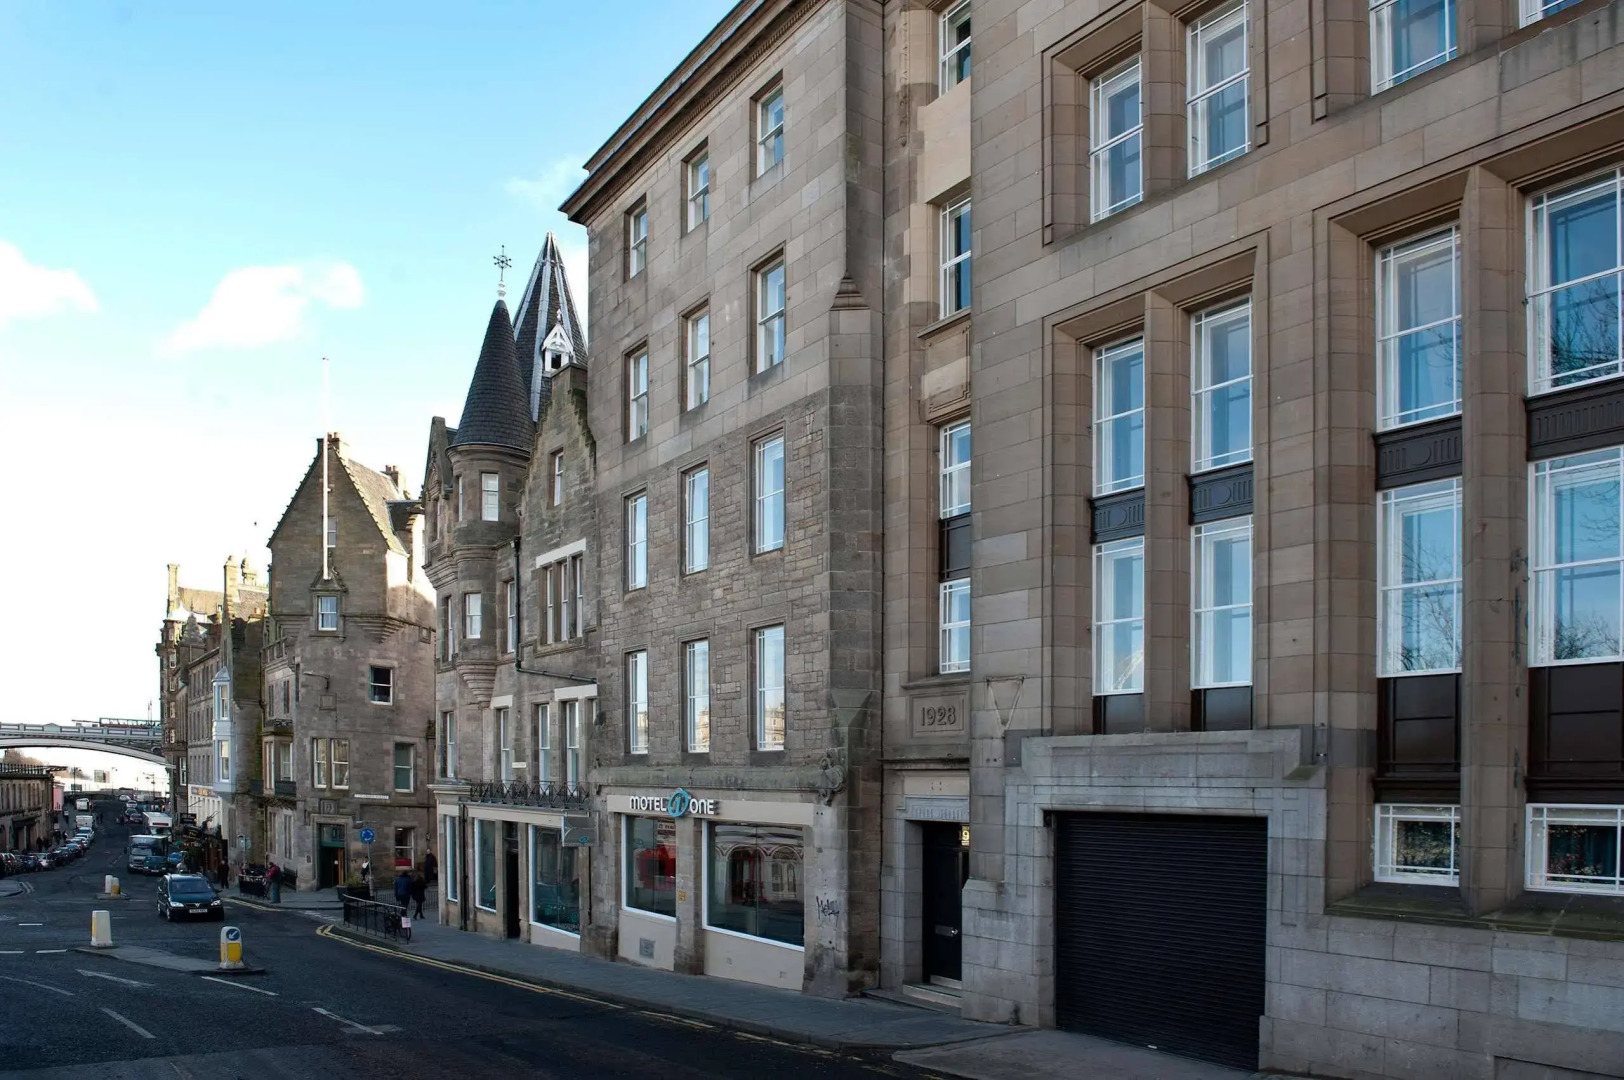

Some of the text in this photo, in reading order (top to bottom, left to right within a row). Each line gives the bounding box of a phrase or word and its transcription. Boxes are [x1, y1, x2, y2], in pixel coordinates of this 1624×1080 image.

[922, 706, 956, 726] 1928
[629, 795, 667, 812] MOTEL
[689, 798, 715, 815] ONE
